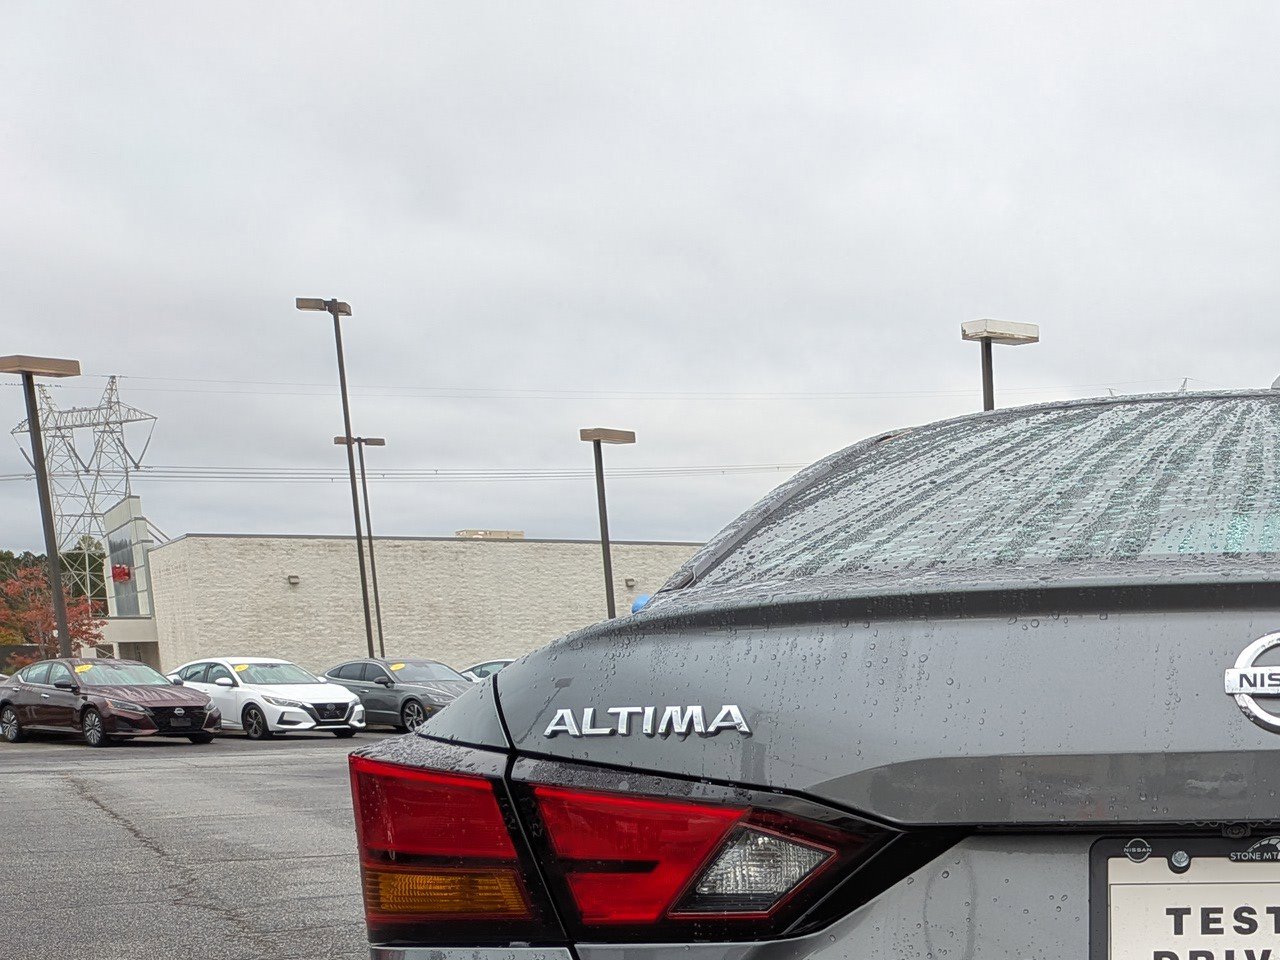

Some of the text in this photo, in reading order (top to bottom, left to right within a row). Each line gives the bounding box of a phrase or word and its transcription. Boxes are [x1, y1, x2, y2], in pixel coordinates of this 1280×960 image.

[543, 704, 752, 739] ALTIMA
[1230, 851, 1279, 860] STONE MT
